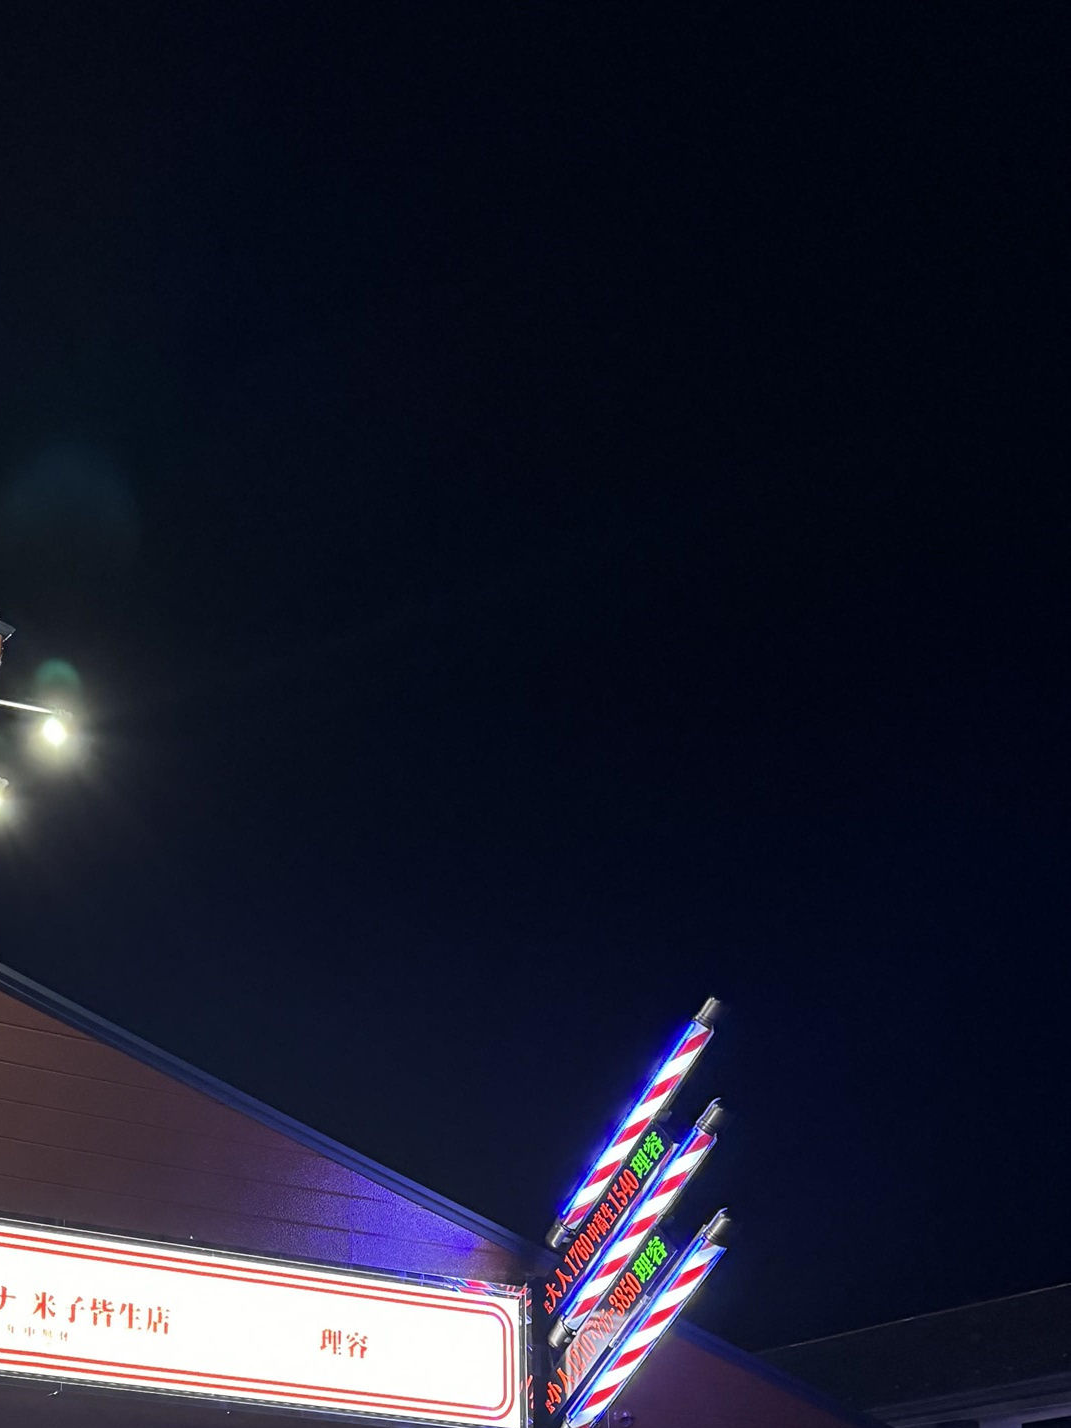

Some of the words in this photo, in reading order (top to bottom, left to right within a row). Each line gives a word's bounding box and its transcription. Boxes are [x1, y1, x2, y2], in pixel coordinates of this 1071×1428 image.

[32, 1291, 171, 1335] 米子皆生店
[319, 1327, 369, 1360] 理容
